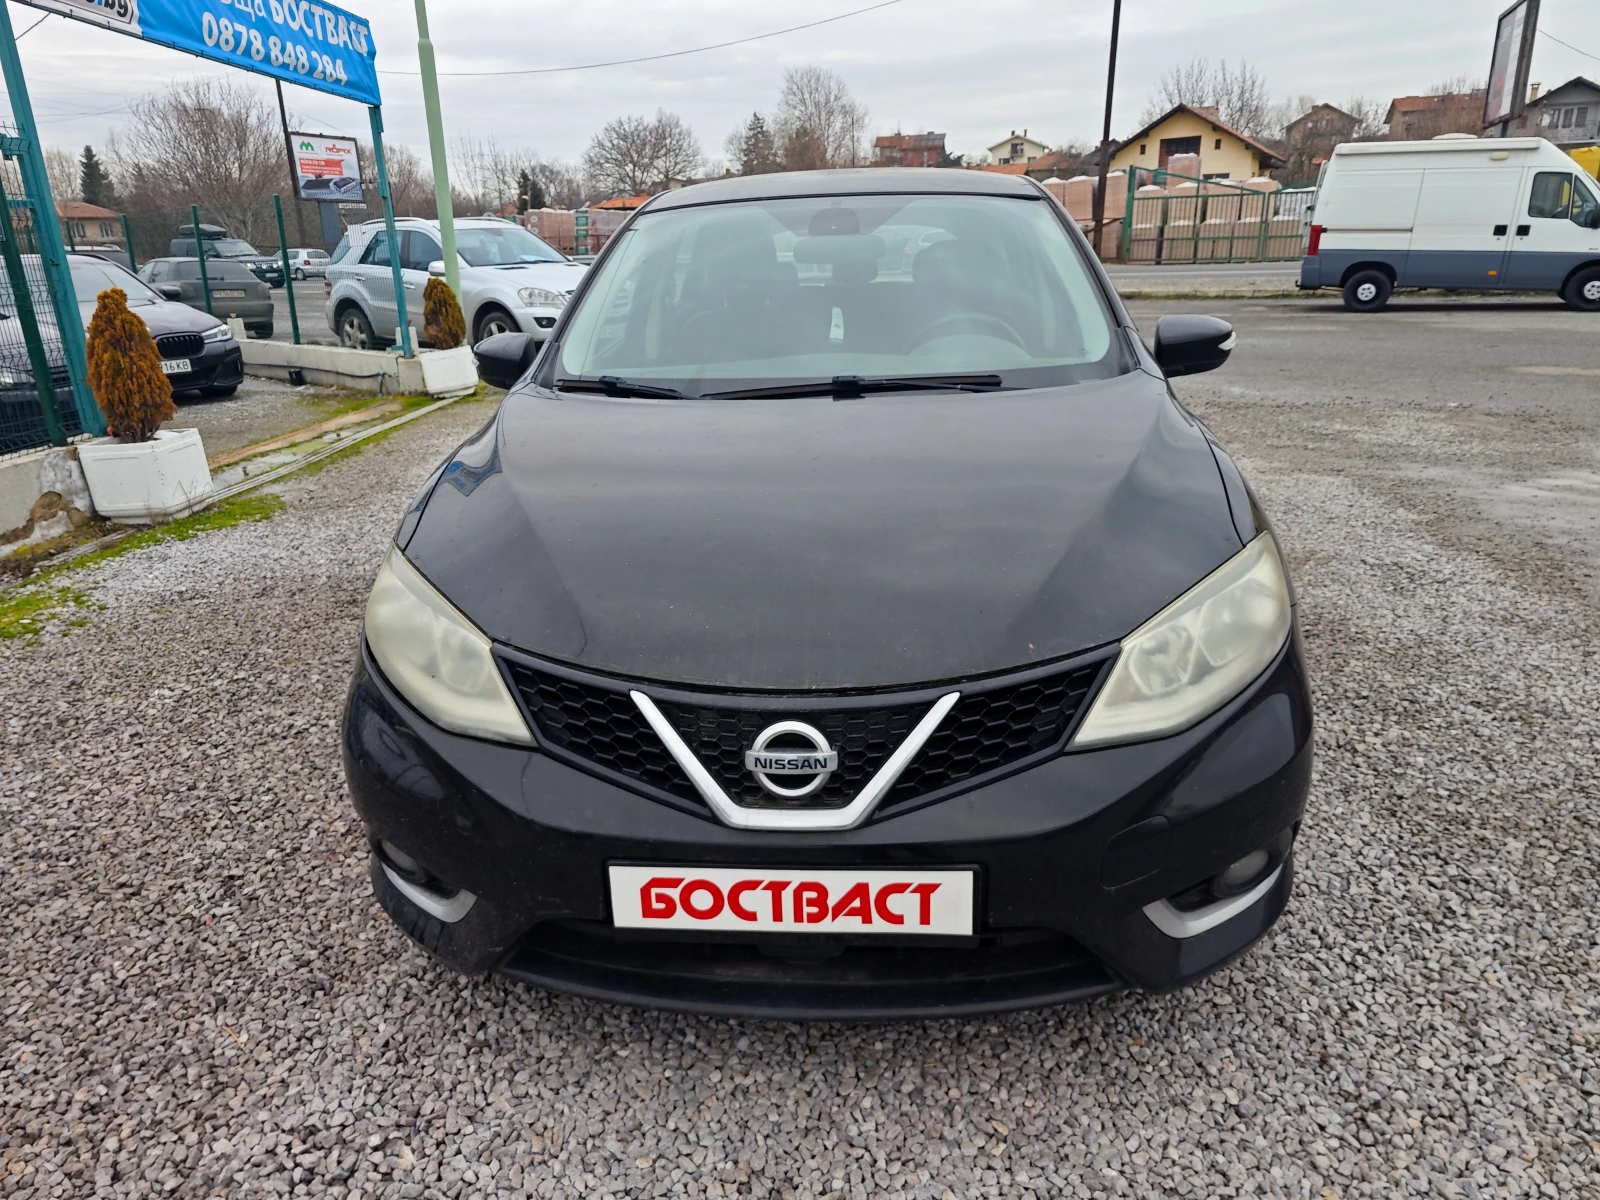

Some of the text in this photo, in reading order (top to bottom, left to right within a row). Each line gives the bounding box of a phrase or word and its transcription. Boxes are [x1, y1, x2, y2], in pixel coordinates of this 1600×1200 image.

[202, 12, 348, 86] 0878 848 284
[269, 0, 369, 56] БОСТВАСТ
[160, 361, 189, 372] 16KB
[754, 756, 828, 771] NISSAN
[640, 877, 942, 926] БОСТВАСТ
